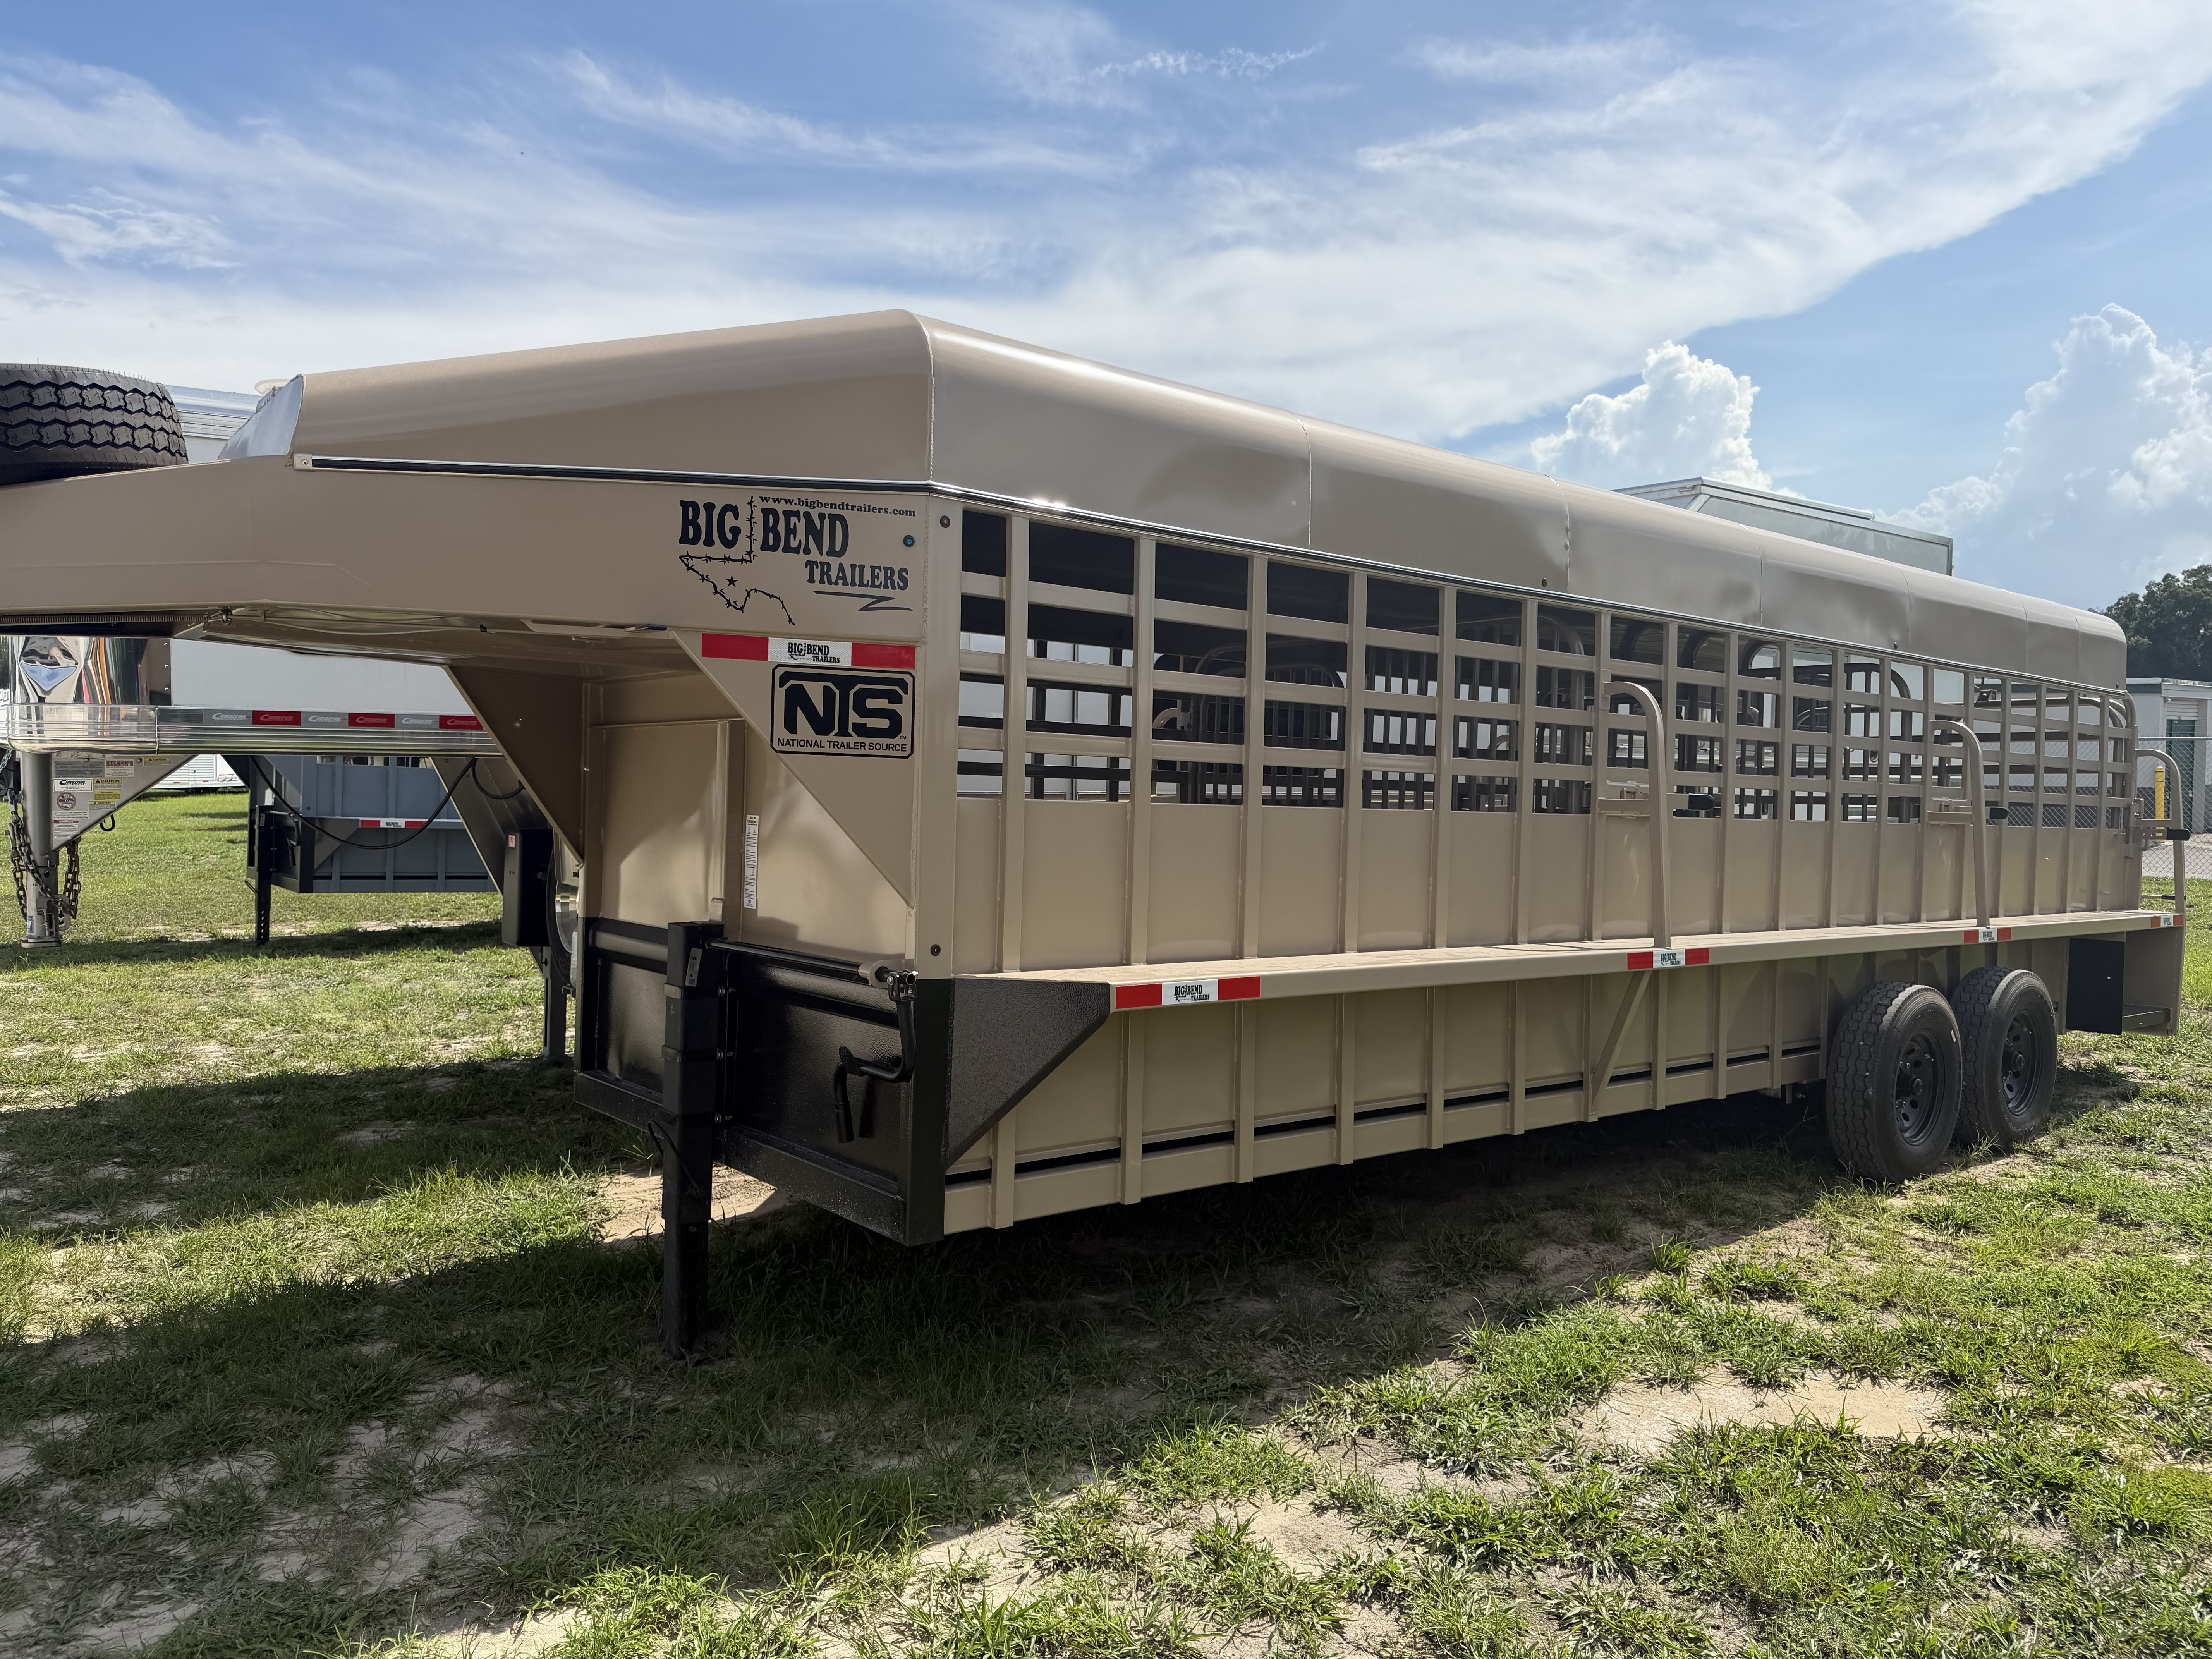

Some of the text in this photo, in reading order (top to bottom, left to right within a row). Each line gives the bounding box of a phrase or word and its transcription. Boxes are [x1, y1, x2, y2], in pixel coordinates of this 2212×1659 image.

[759, 496, 916, 517] www.bigbendtrailers.com
[679, 500, 849, 558] BIG BEND
[805, 560, 909, 591] TRAILERS
[788, 642, 830, 656] BIG BEND
[779, 671, 908, 739] NTS
[777, 738, 907, 752] NATIONAL TRAILER SOURCE
[1174, 984, 1202, 996] BIG BEND
